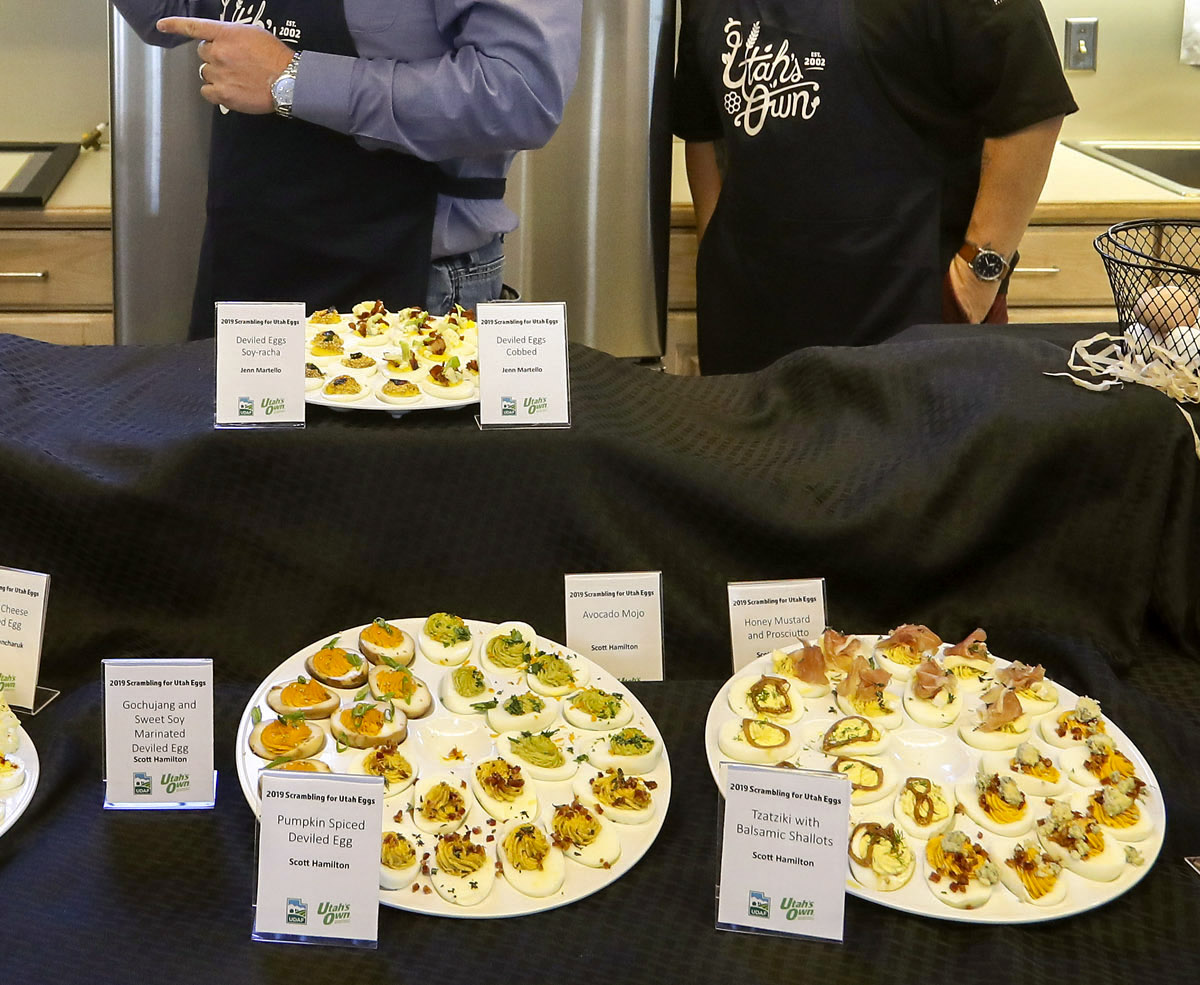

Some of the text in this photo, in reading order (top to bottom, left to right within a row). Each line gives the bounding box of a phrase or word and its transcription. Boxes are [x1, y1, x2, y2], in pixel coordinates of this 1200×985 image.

[286, 19, 297, 28] EST.
[279, 26, 301, 38] 2002
[804, 58, 826, 67] 2002
[269, 337, 286, 345] Eggs
[497, 336, 546, 345] Deviled Eggs
[242, 349, 280, 357] Soy-racha
[507, 348, 537, 356] Cobbed
[1, 604, 28, 616] Cheese
[583, 609, 644, 619] Avocado Mojo
[8, 619, 21, 631] Egg
[745, 615, 810, 627] Honey Mustard
[748, 629, 809, 639] and Prosciutto
[123, 700, 196, 711] Gochujang and
[135, 715, 184, 725] Sweet Soy
[134, 729, 185, 738] Marinated
[132, 744, 188, 754] Deviled Egg
[286, 792, 325, 803] Scrambling
[339, 795, 356, 803] Utah
[358, 797, 375, 806] Eggs
[730, 783, 841, 805] 2019 Scrambling for Utah Eggs
[277, 815, 365, 830] Pumpkin Spiced
[752, 809, 820, 828] Tzatziki with
[288, 832, 352, 848] Deviled Egg
[737, 824, 833, 847] Balsamic Shallots
[289, 858, 349, 869] Scott Hamilton
[752, 852, 814, 867] Scott Hamilton
[317, 902, 350, 915] Utah's
[780, 897, 814, 910] Utah's
[323, 912, 350, 925] Own
[786, 908, 814, 921] Own
